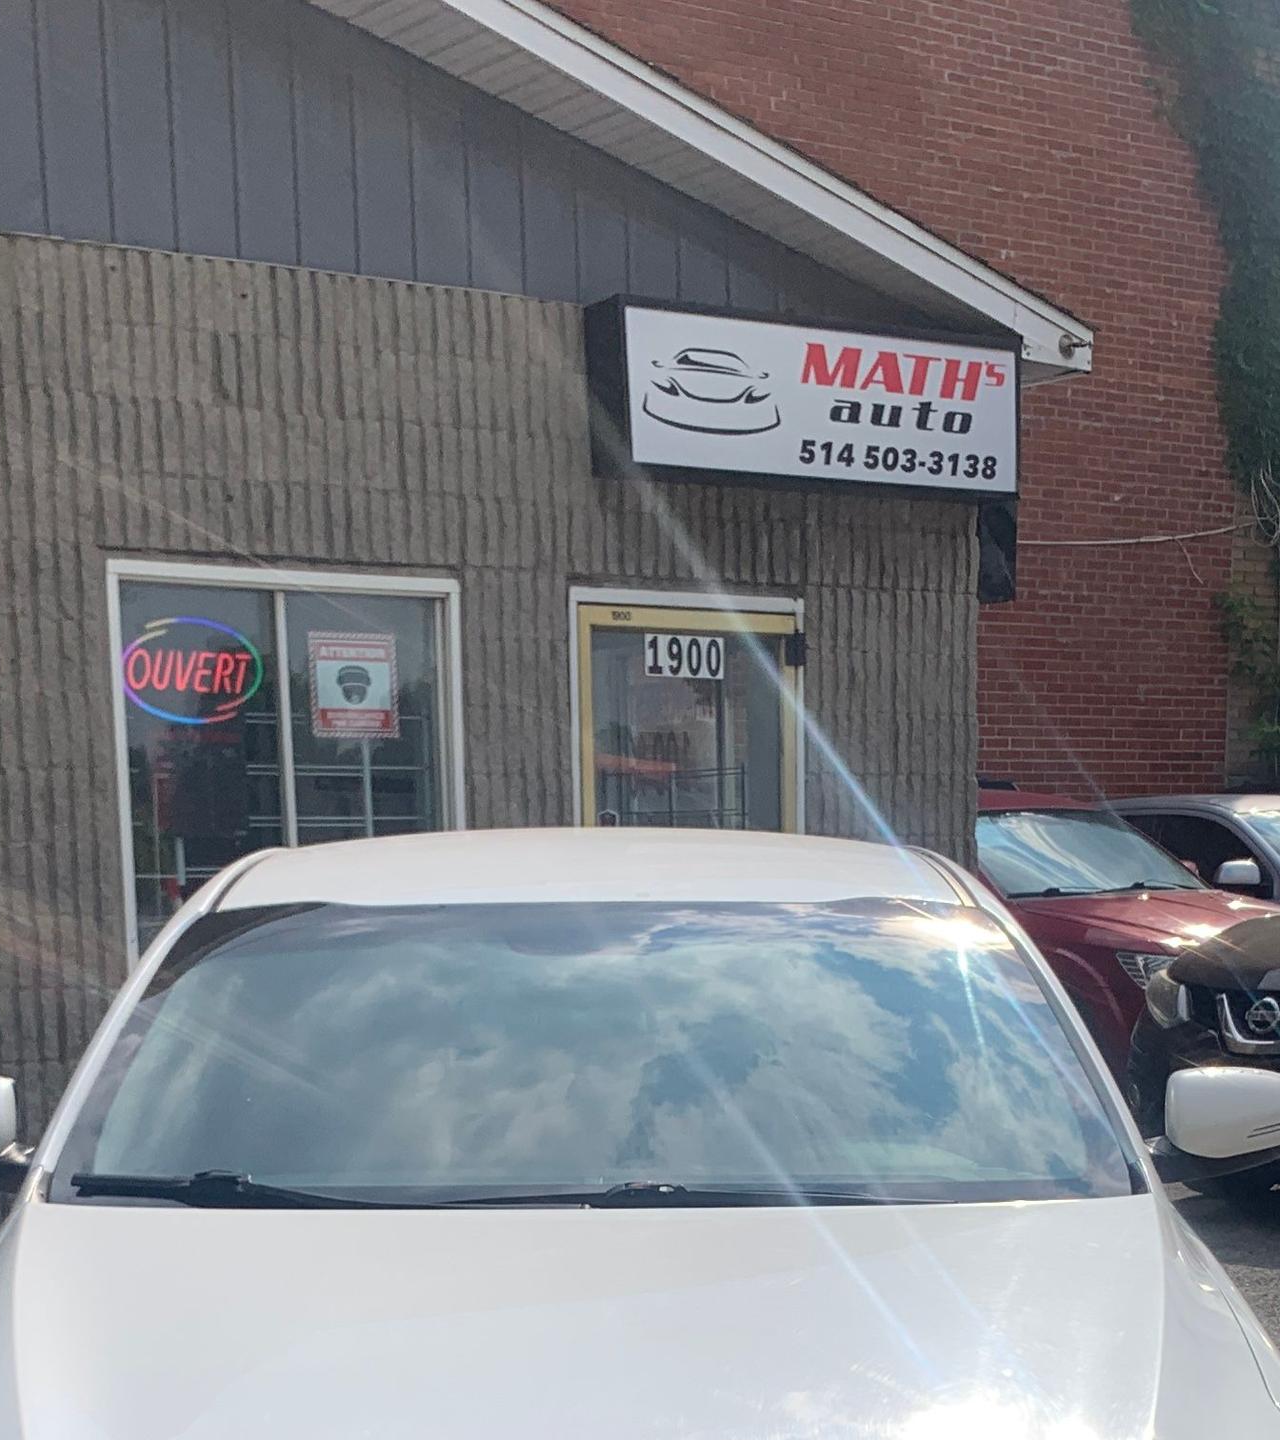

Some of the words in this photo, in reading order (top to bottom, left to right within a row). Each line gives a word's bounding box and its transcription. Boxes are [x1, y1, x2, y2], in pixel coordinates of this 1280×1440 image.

[829, 399, 973, 434] auto
[799, 439, 855, 467] 514
[863, 445, 998, 480] 503-3138
[126, 647, 253, 694] OUVERT
[647, 635, 721, 677] 1900
